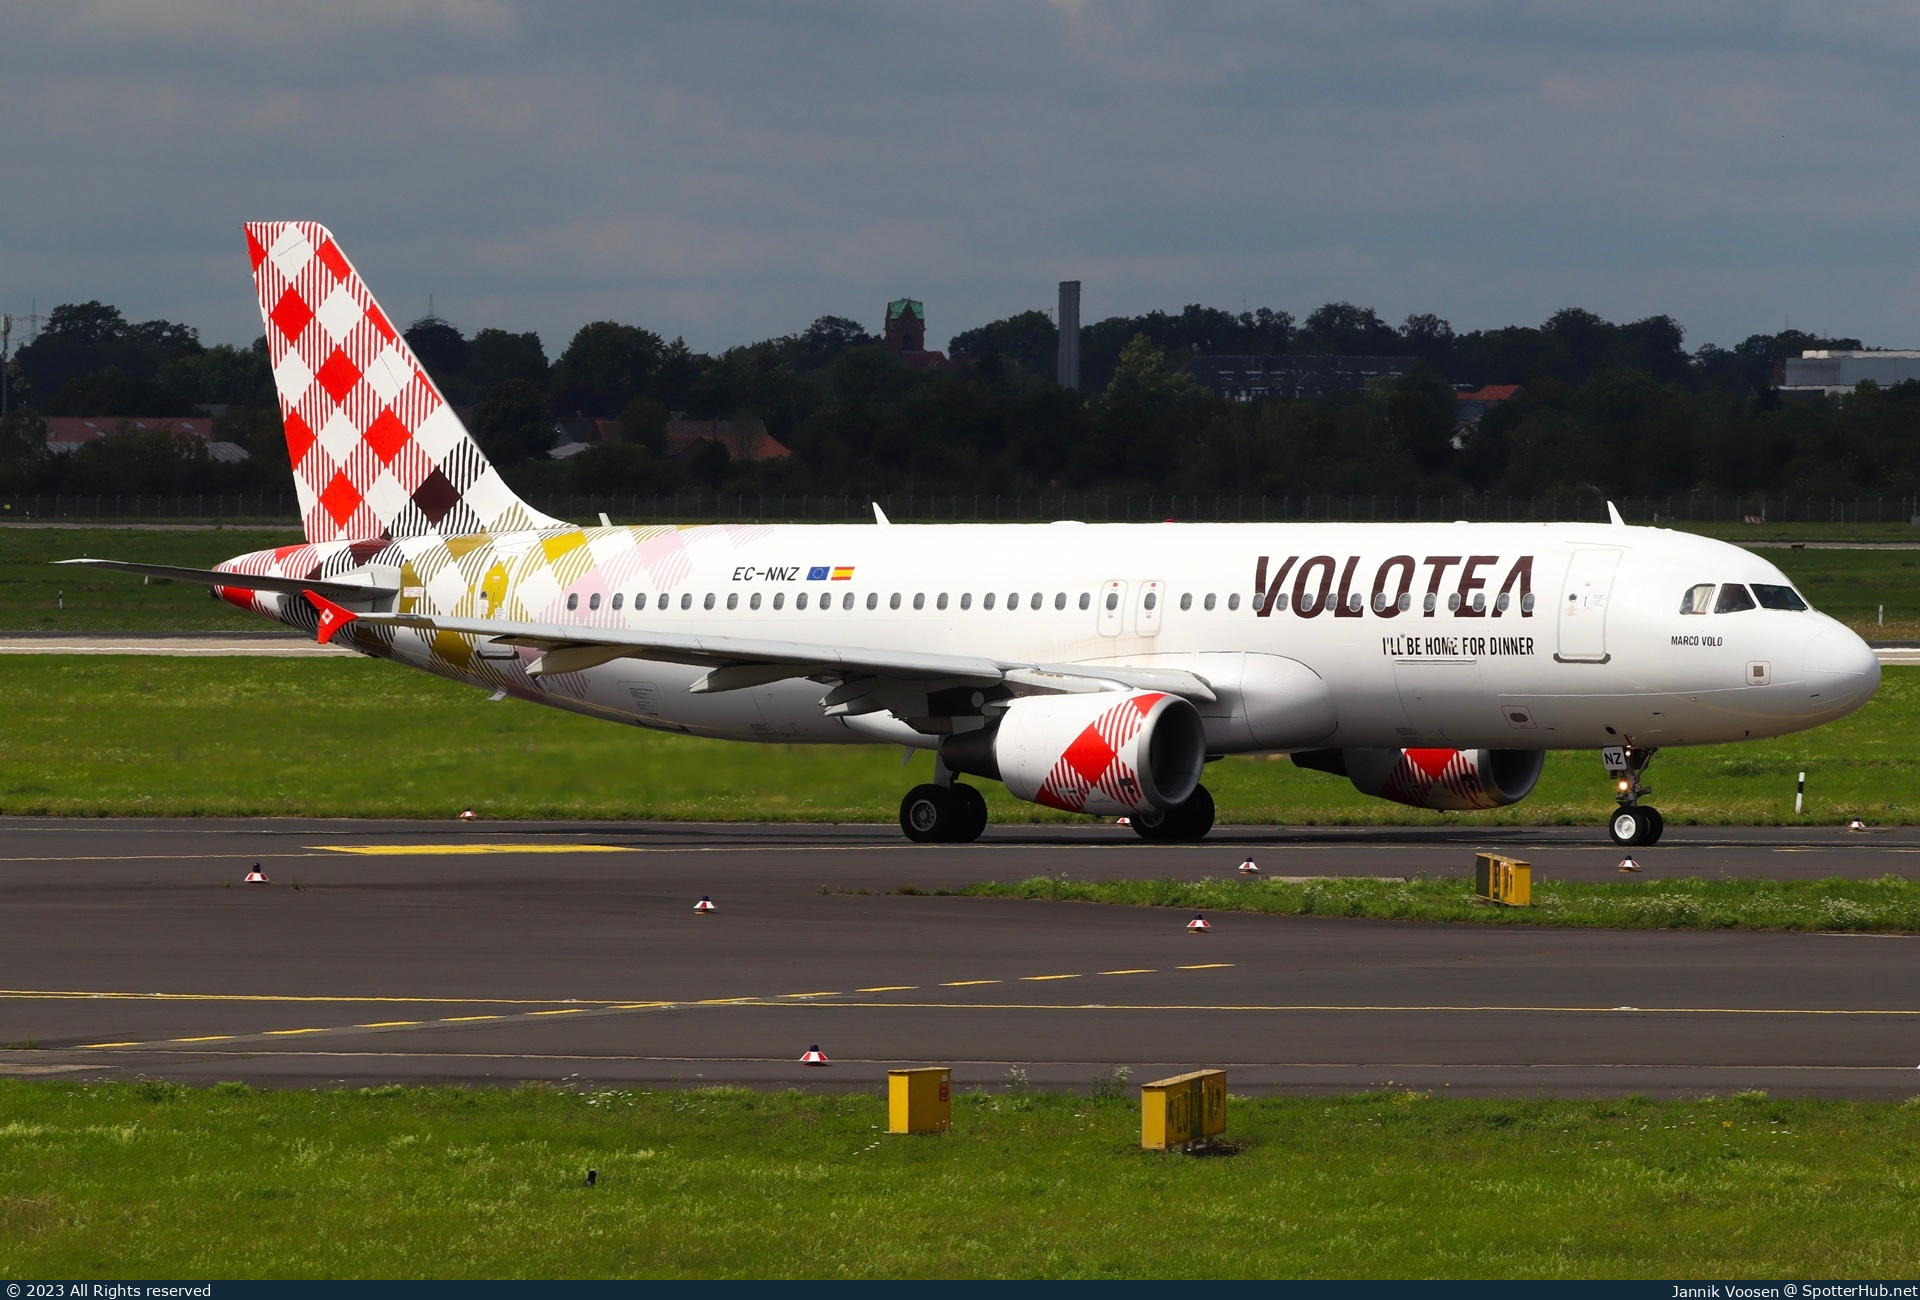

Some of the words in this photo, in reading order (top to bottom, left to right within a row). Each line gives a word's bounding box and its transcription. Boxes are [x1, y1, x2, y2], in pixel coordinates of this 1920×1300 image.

[732, 566, 800, 581] EC-NNZ
[1255, 555, 1534, 618] VOLOTEA
[1382, 637, 1404, 655] I'LL
[1406, 637, 1422, 655] BE
[1425, 637, 1459, 656] HOME
[1462, 637, 1486, 656] FOR
[1490, 637, 1534, 656] DINNER
[1671, 635, 1699, 646] MARCO
[1701, 636, 1723, 647] VOLO
[1604, 752, 1623, 765] NZ
